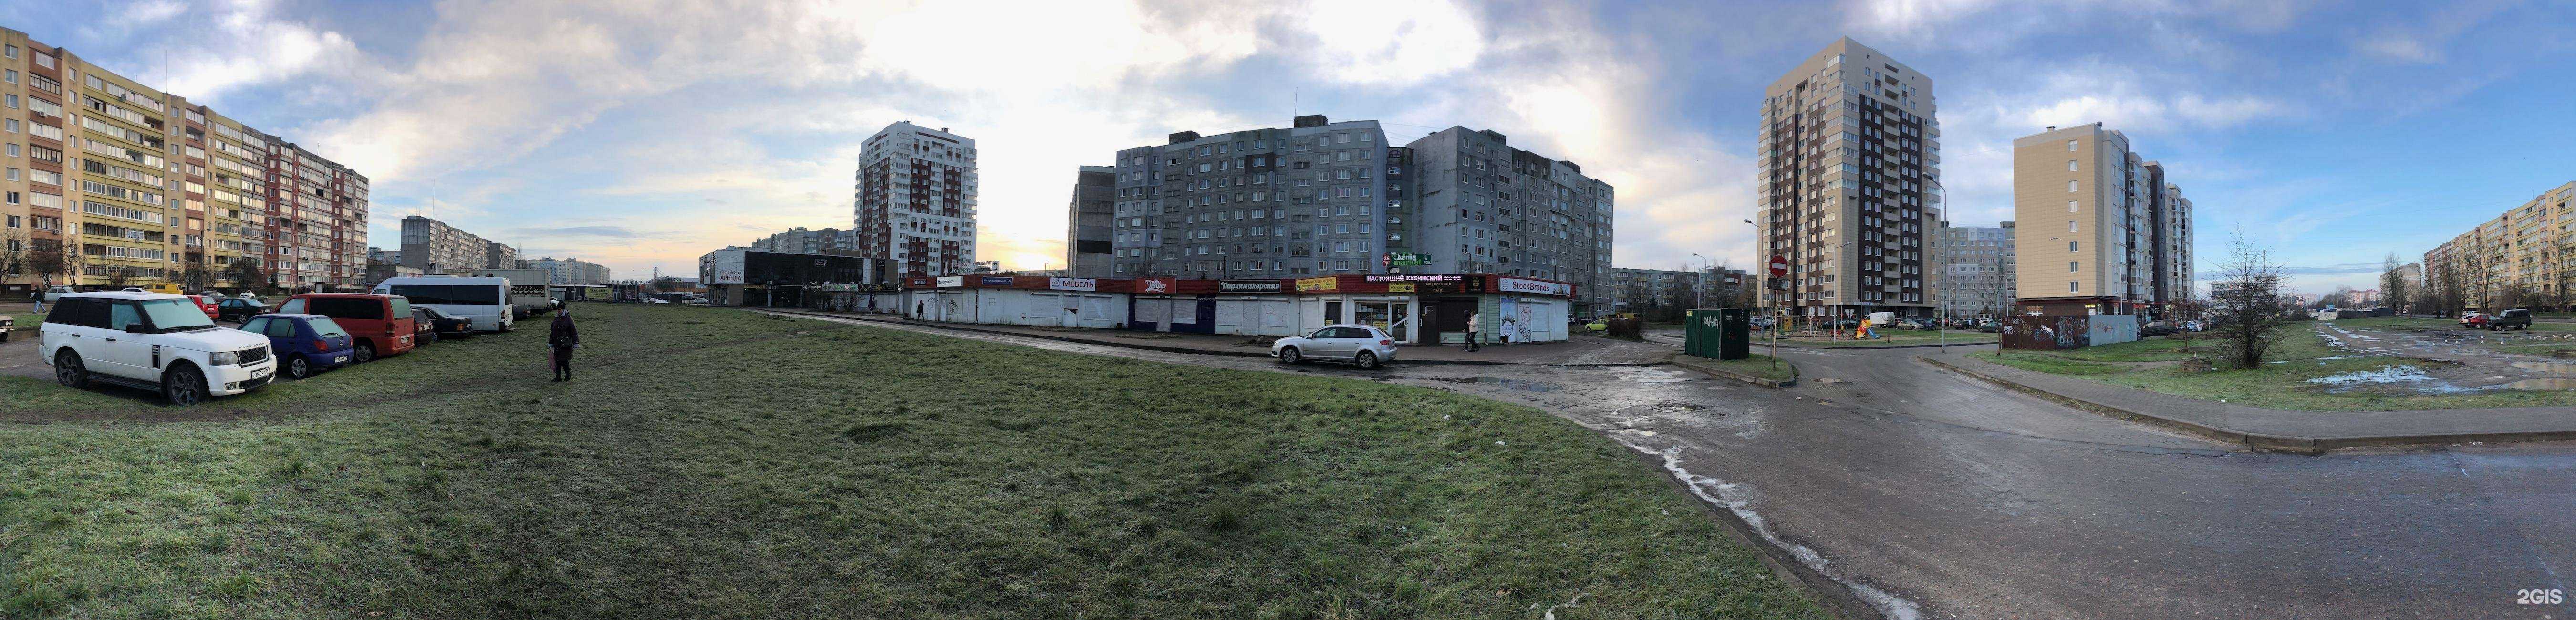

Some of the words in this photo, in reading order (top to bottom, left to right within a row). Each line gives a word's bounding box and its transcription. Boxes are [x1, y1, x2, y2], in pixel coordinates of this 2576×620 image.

[511, 285, 545, 294] illies
[1221, 282, 1279, 291] Парикмахерская
[1512, 281, 1550, 292] StockBrands
